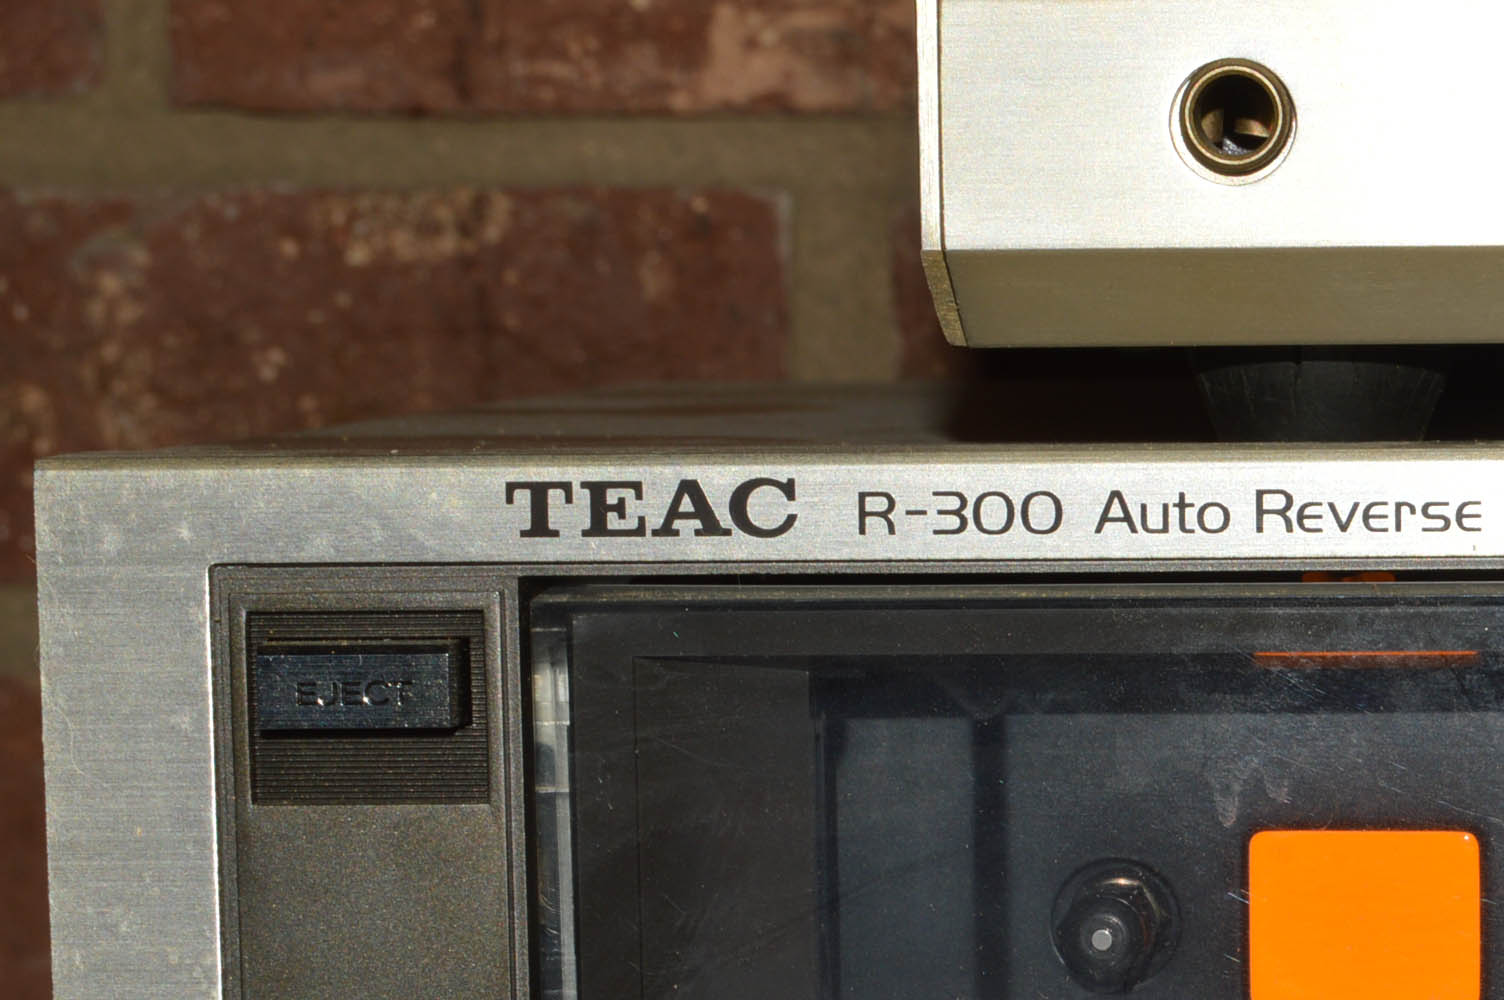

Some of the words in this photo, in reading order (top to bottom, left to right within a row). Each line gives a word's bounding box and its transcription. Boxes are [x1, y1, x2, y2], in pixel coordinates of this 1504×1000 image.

[505, 477, 798, 539] TEAC
[857, 490, 1063, 536] R-300
[1094, 489, 1231, 534] Auto
[1255, 488, 1482, 534] Reverse
[295, 679, 413, 706] EJECT
